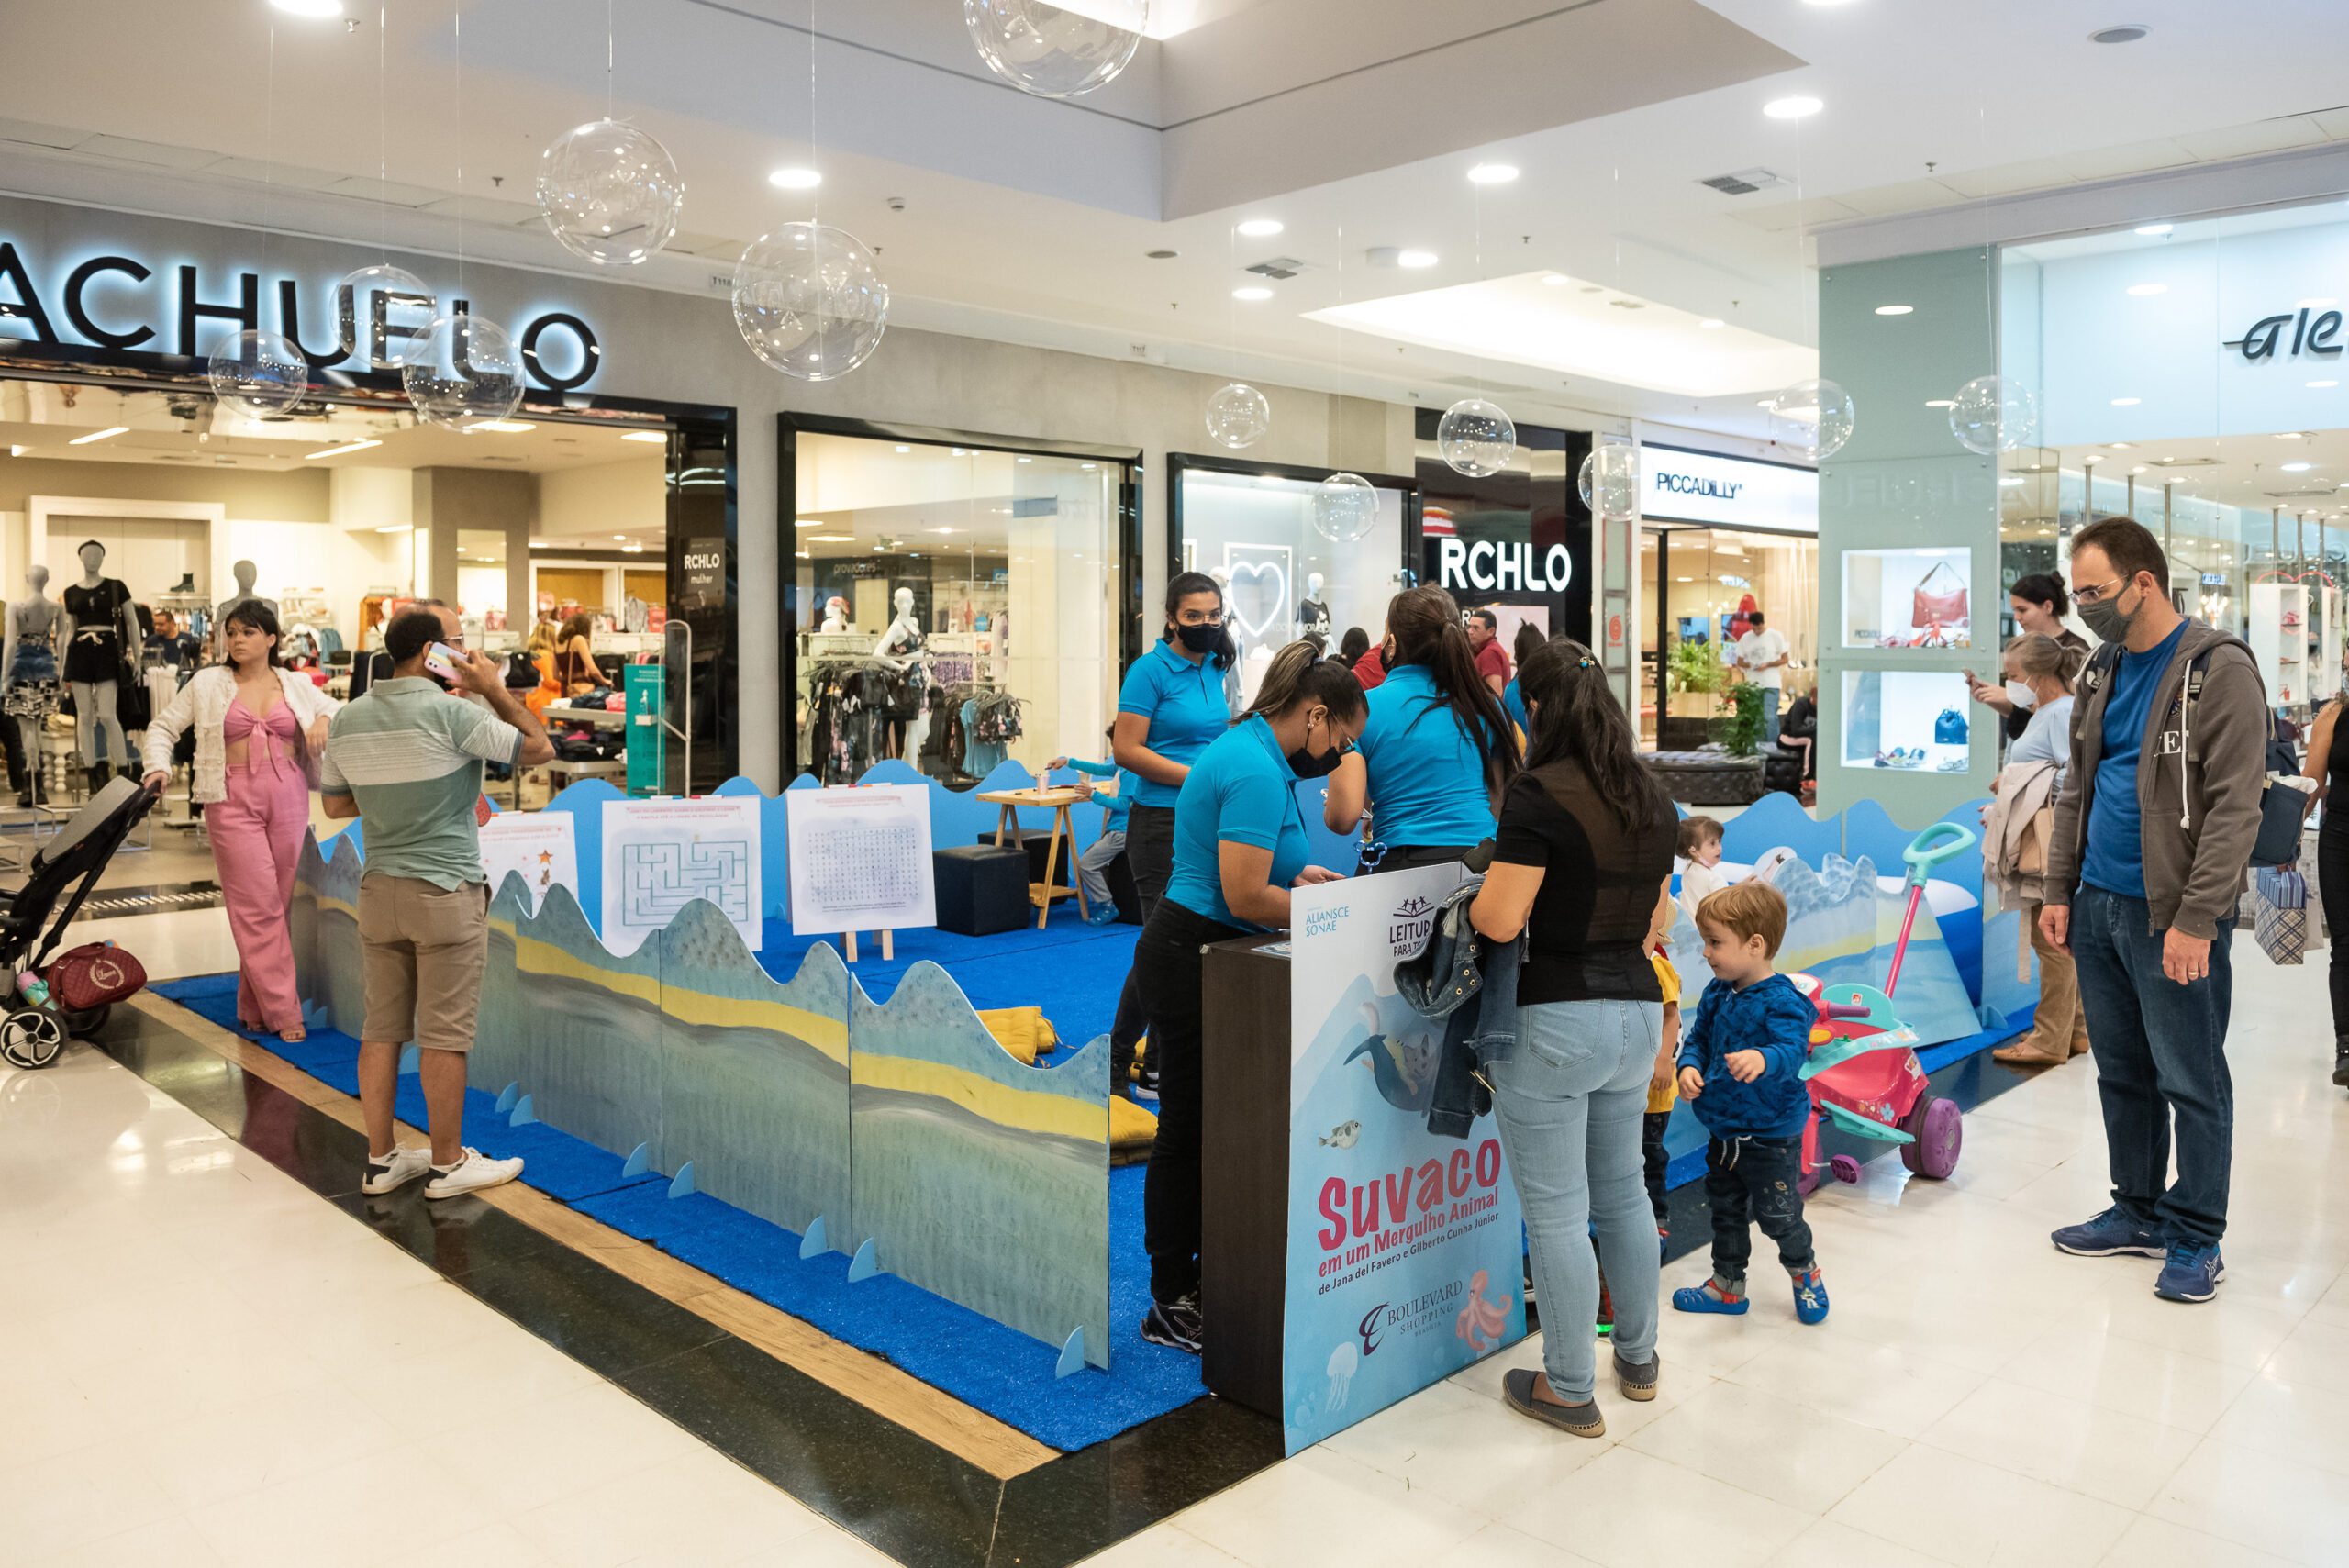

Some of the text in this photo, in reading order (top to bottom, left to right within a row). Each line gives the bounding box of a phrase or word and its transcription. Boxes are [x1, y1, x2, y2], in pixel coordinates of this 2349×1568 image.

[1657, 473, 1738, 499] PICCADILLY
[684, 553, 720, 570] RCHLO
[1440, 538, 1572, 593] RCHLO
[691, 573, 713, 584] mulher
[1305, 906, 1350, 926] ALIANSCE
[1306, 920, 1337, 938] SONAE
[1389, 919, 1431, 944] LEITUR
[1393, 944, 1412, 957] PARA
[1318, 1139, 1501, 1251] Suvaco
[1319, 1186, 1498, 1277] em um Mergulho Animal
[1319, 1212, 1499, 1296] de Jana del Favero e Gilberto Cunha Júnior
[1387, 1280, 1463, 1327] BOULEVARD
[1400, 1303, 1453, 1335] SHOPPING
